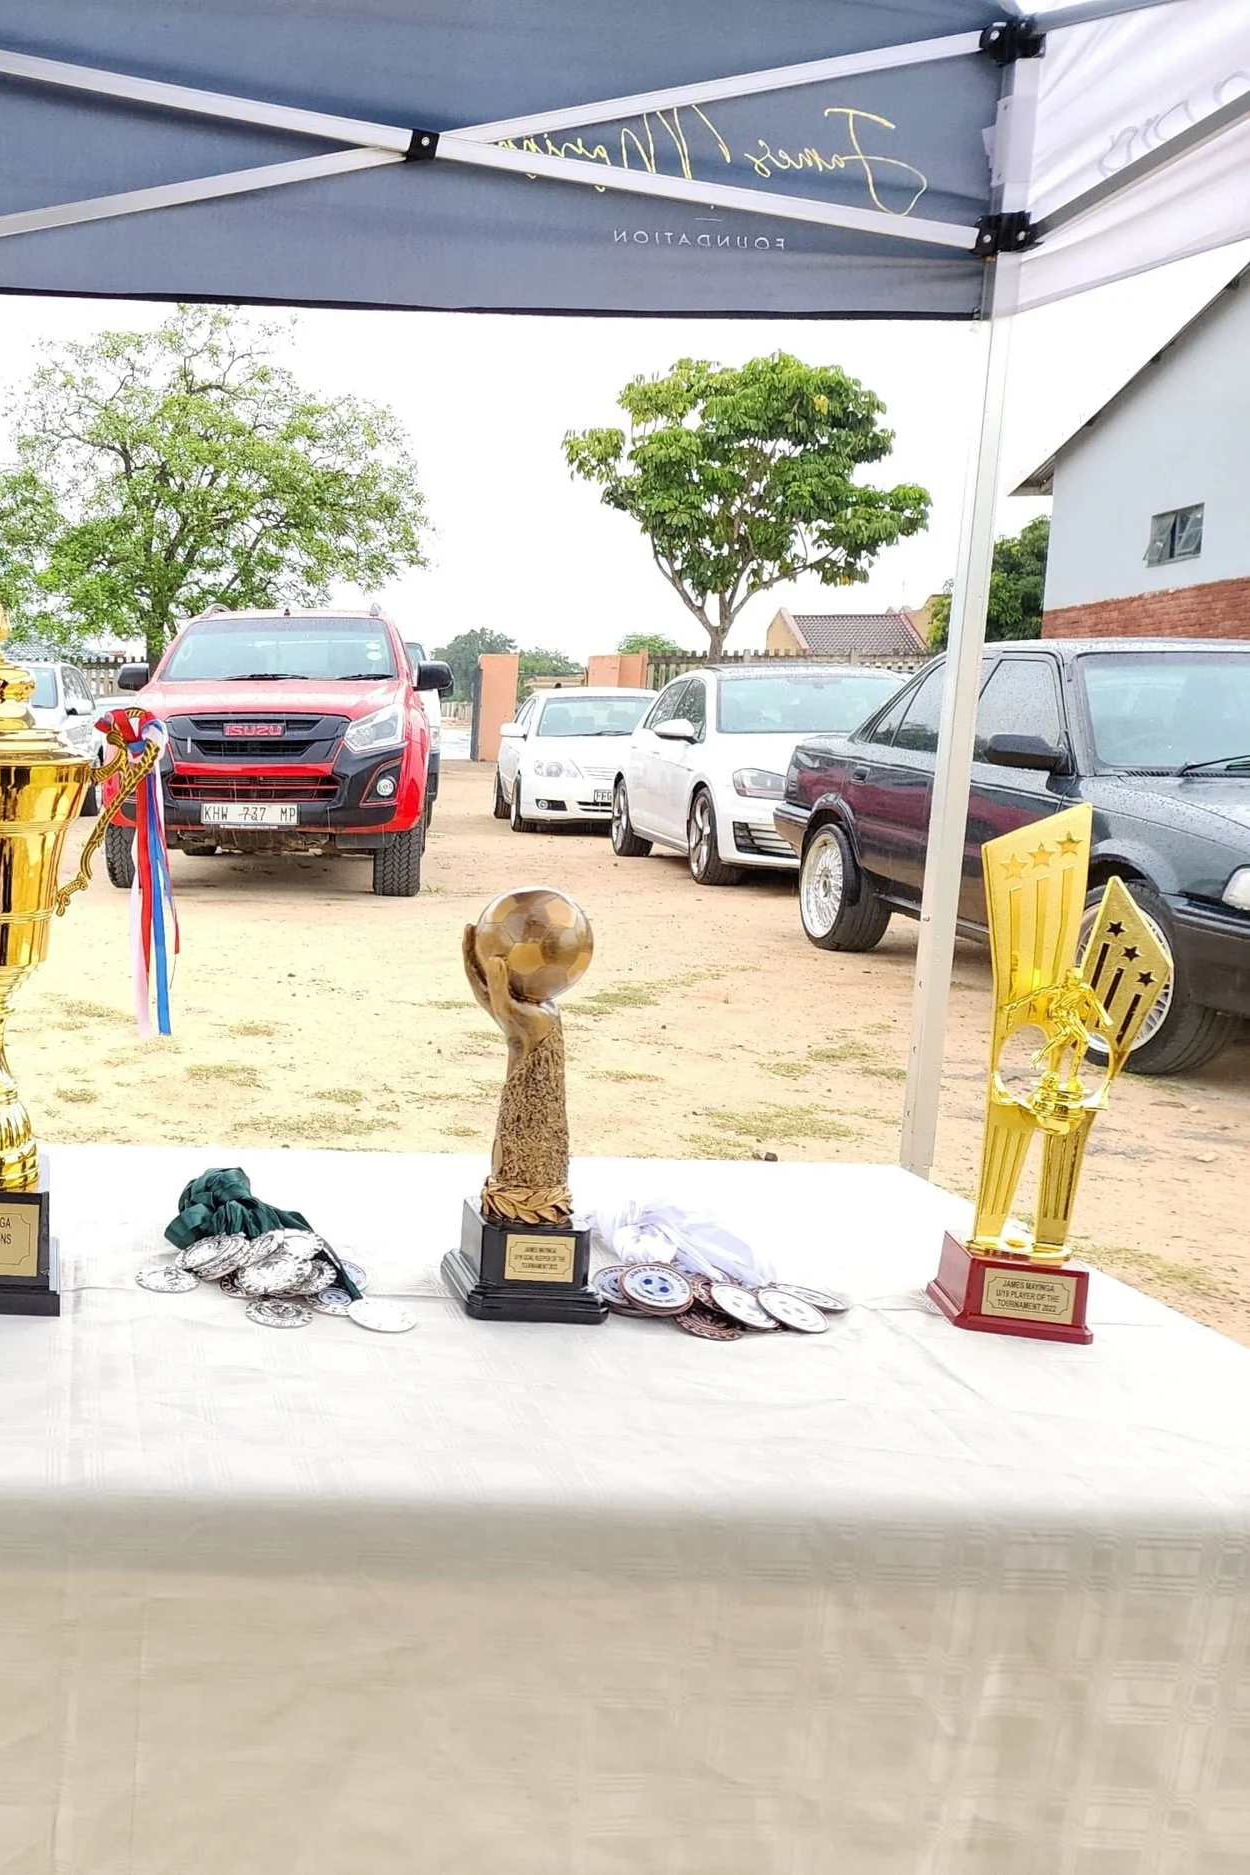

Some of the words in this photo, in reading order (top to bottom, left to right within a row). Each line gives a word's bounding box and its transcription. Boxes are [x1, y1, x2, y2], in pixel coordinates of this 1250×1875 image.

[224, 725, 282, 736] ISUZU
[204, 806, 228, 821] KHW
[243, 806, 266, 821] 737
[280, 807, 296, 821] MP
[1003, 1280, 1025, 1289] JAMES
[1025, 1282, 1055, 1292] MAYINGA
[996, 1288, 1010, 1298] U/19
[1010, 1291, 1036, 1300] PLAYER
[1036, 1293, 1047, 1301] OF
[1047, 1294, 1061, 1303] THE
[997, 1298, 1041, 1311] TOURNAMENT
[1041, 1304, 1057, 1312] 2022
